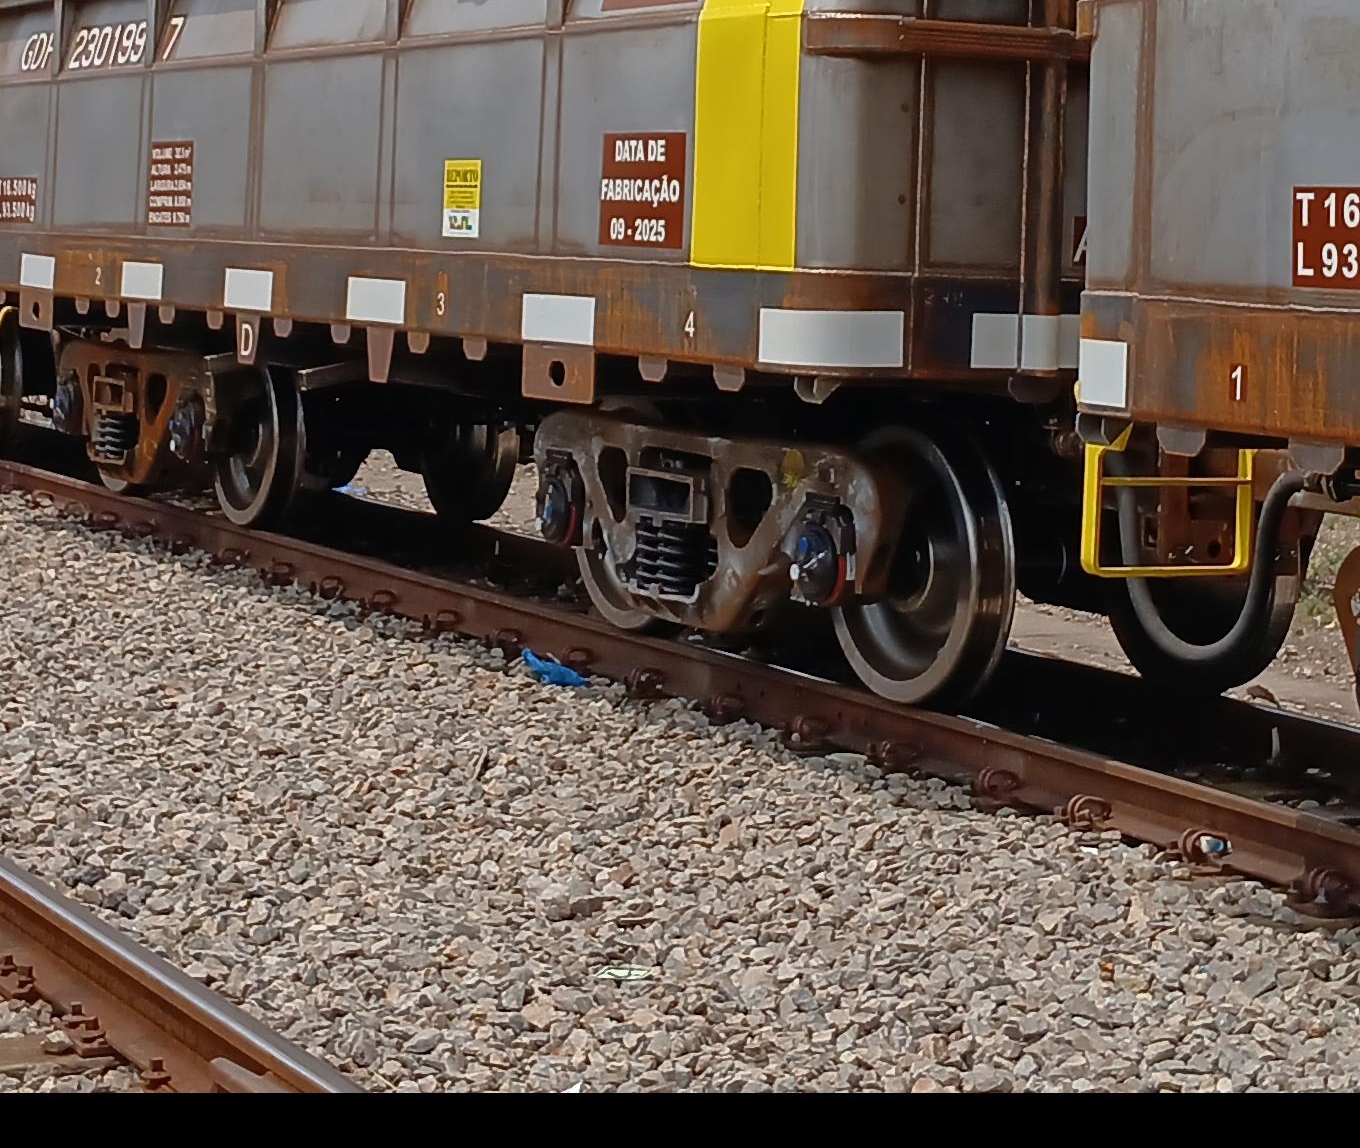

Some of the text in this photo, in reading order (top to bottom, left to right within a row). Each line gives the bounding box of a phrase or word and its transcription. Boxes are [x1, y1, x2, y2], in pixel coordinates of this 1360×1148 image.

[161, 16, 185, 61] 7
[615, 139, 666, 162] DATA DE
[600, 174, 680, 208] FABRICAÇÃO
[1296, 192, 1314, 228] T
[609, 217, 626, 241] 09
[633, 218, 667, 243] 2025
[1296, 241, 1315, 278] L
[436, 292, 446, 315] 3
[240, 322, 253, 356] D
[684, 310, 696, 338] 4
[1231, 365, 1243, 401] 1
